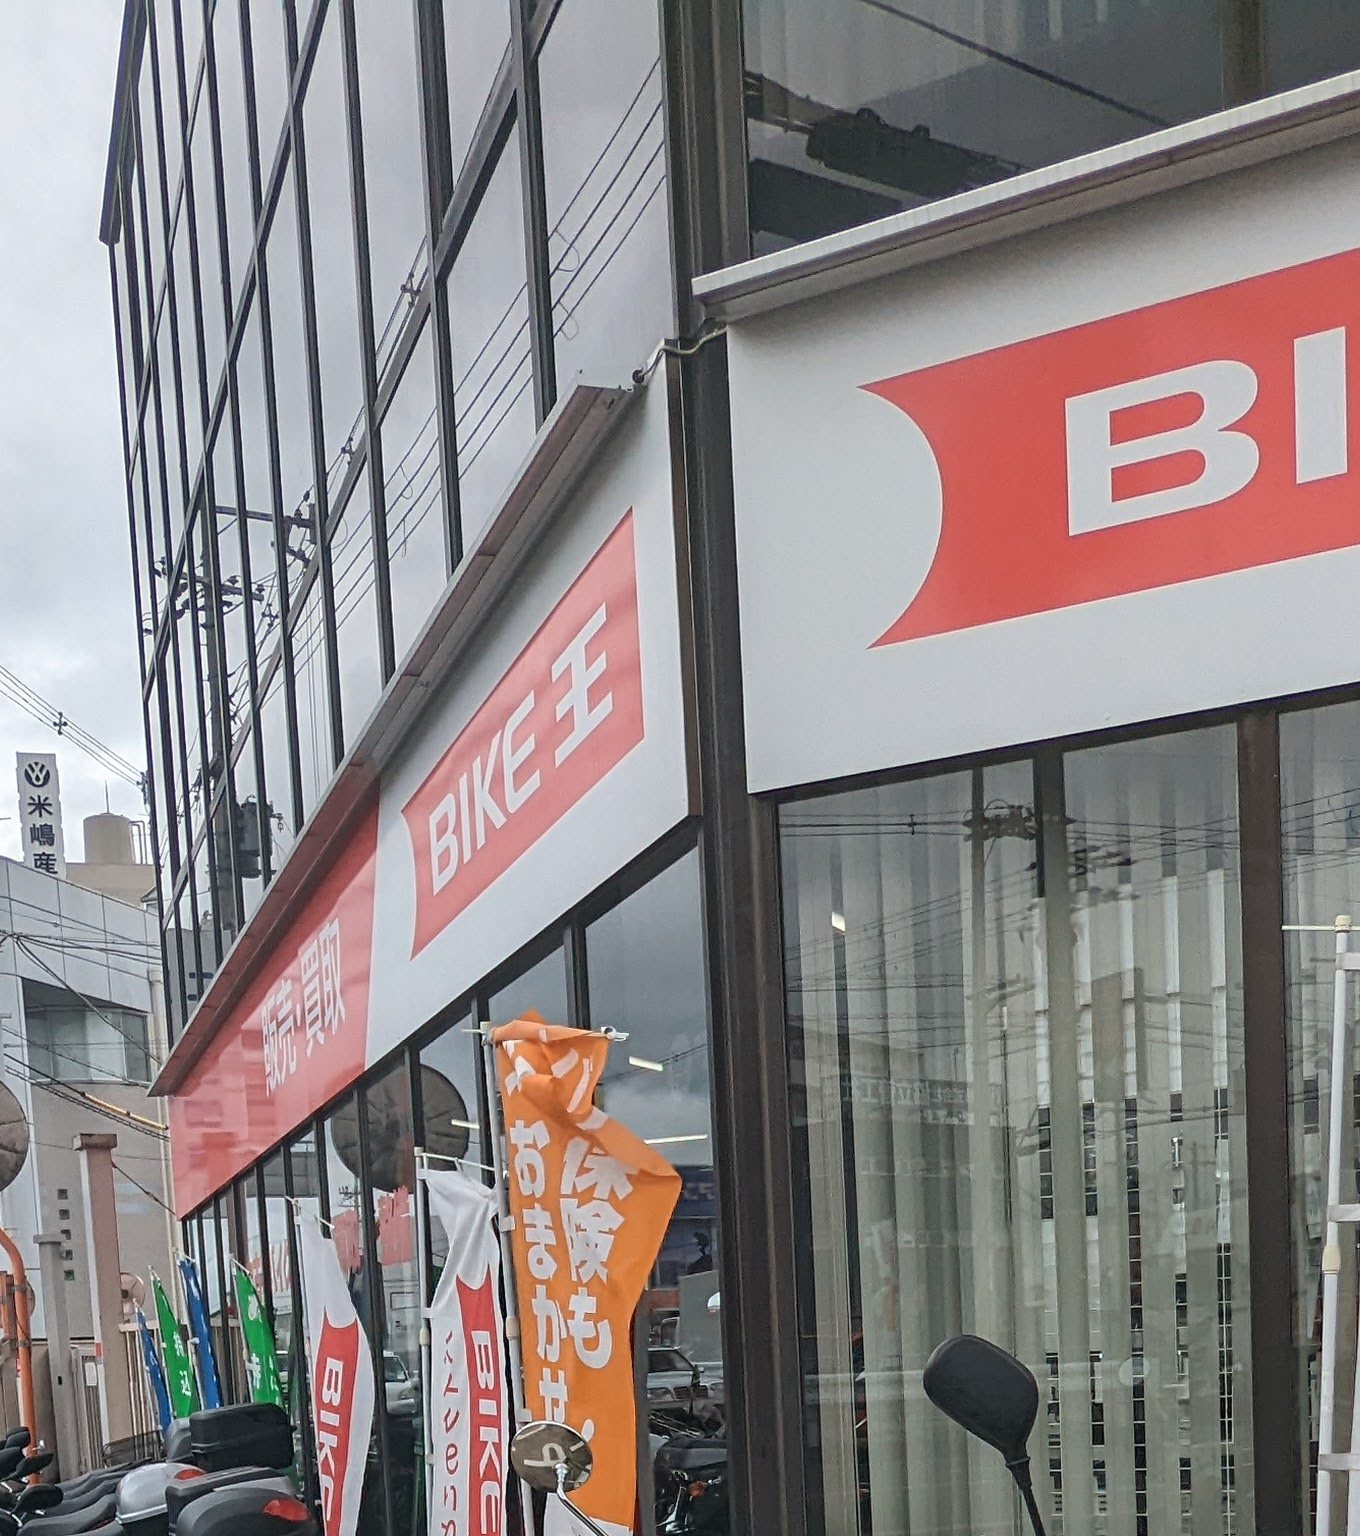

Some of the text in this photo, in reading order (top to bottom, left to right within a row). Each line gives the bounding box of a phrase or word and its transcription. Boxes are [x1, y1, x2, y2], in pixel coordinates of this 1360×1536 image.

[426, 601, 614, 897] BIKE 王
[471, 1330, 500, 1535] BIKE
